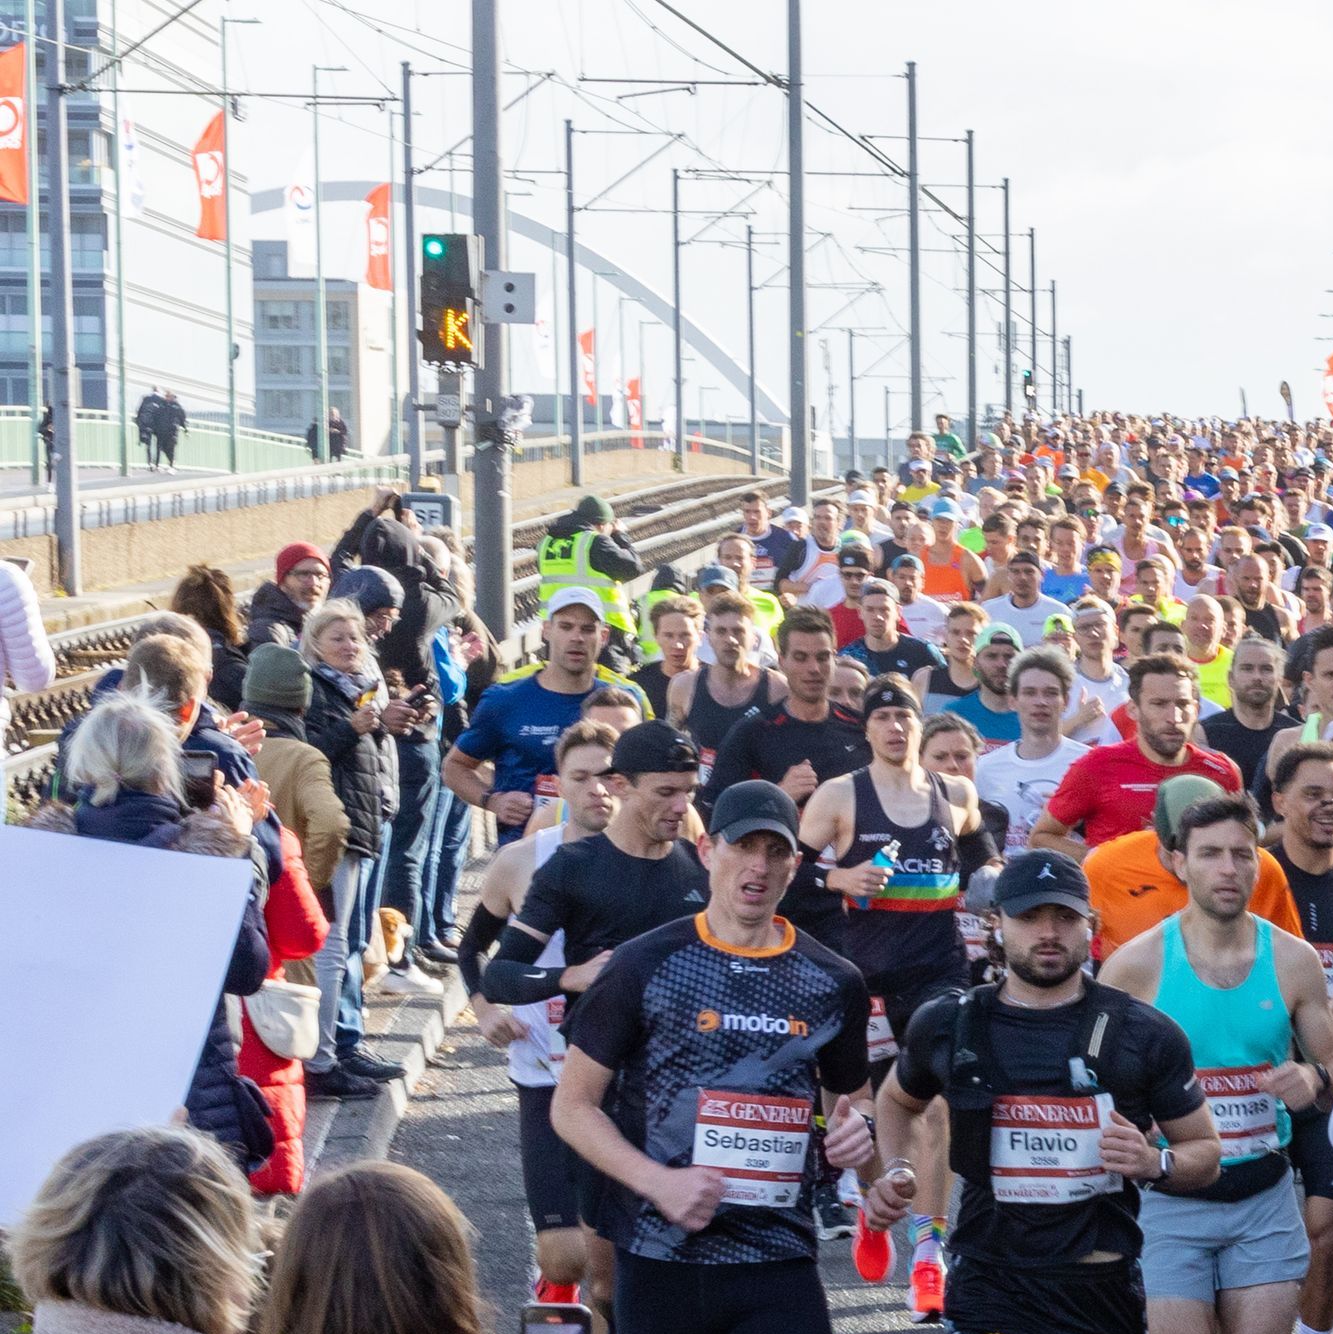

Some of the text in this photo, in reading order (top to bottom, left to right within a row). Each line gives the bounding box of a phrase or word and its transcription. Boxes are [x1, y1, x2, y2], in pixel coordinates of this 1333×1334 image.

[894, 858, 943, 873] ACH3
[723, 1013, 809, 1037] motoin
[1200, 1074, 1257, 1091] GENER
[730, 1102, 810, 1125] GENERALI
[1010, 1104, 1096, 1123] GENERALI
[1210, 1098, 1269, 1117] omas
[704, 1129, 803, 1154] Sebastian
[1009, 1131, 1078, 1152] Flavio
